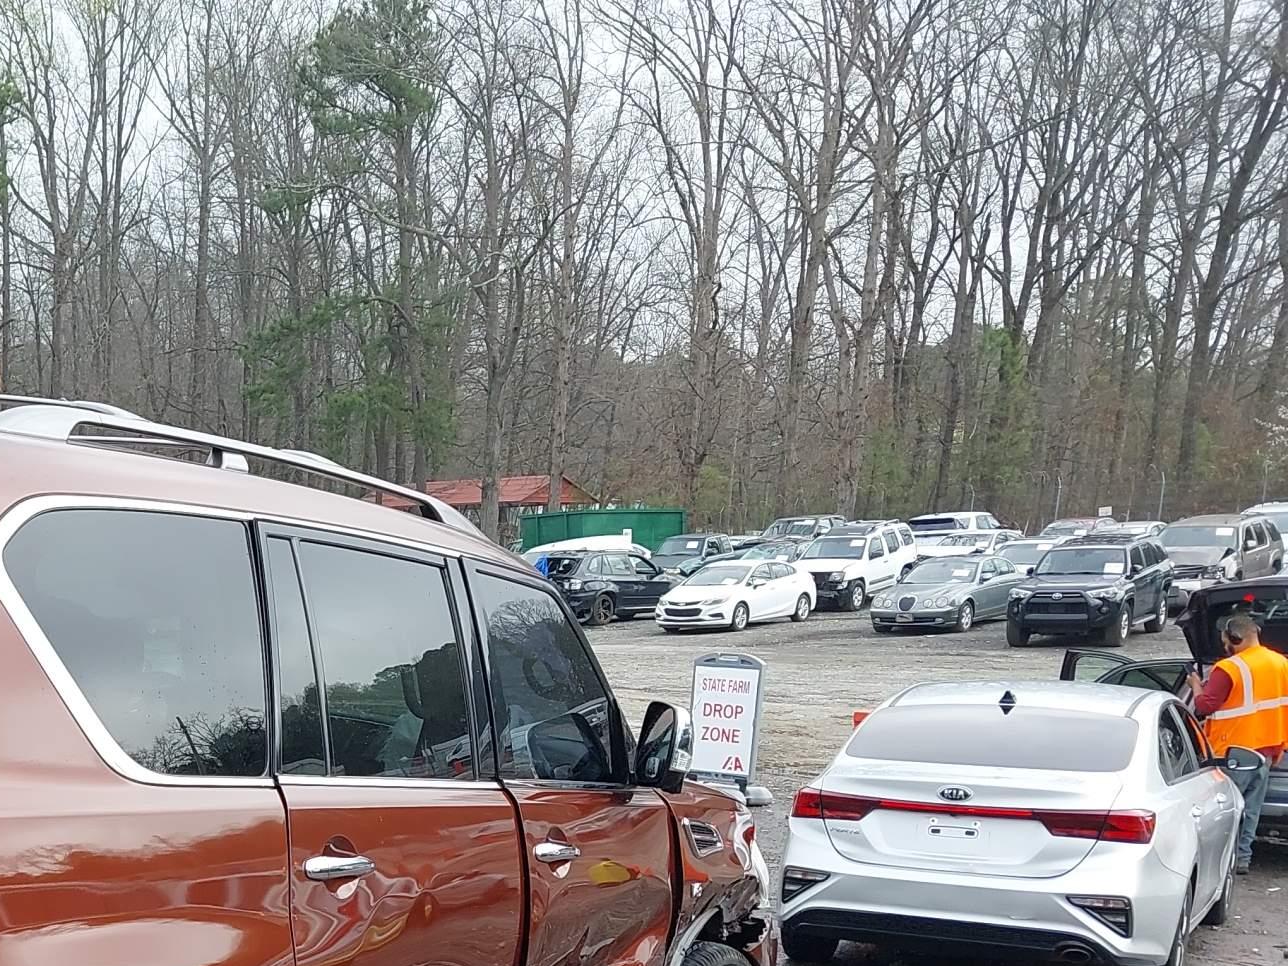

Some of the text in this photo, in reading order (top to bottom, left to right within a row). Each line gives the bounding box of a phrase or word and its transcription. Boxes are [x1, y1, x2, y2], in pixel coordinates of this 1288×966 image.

[702, 678, 751, 694] STATE FARM
[703, 703, 744, 719] DROP
[701, 726, 741, 743] ZONE
